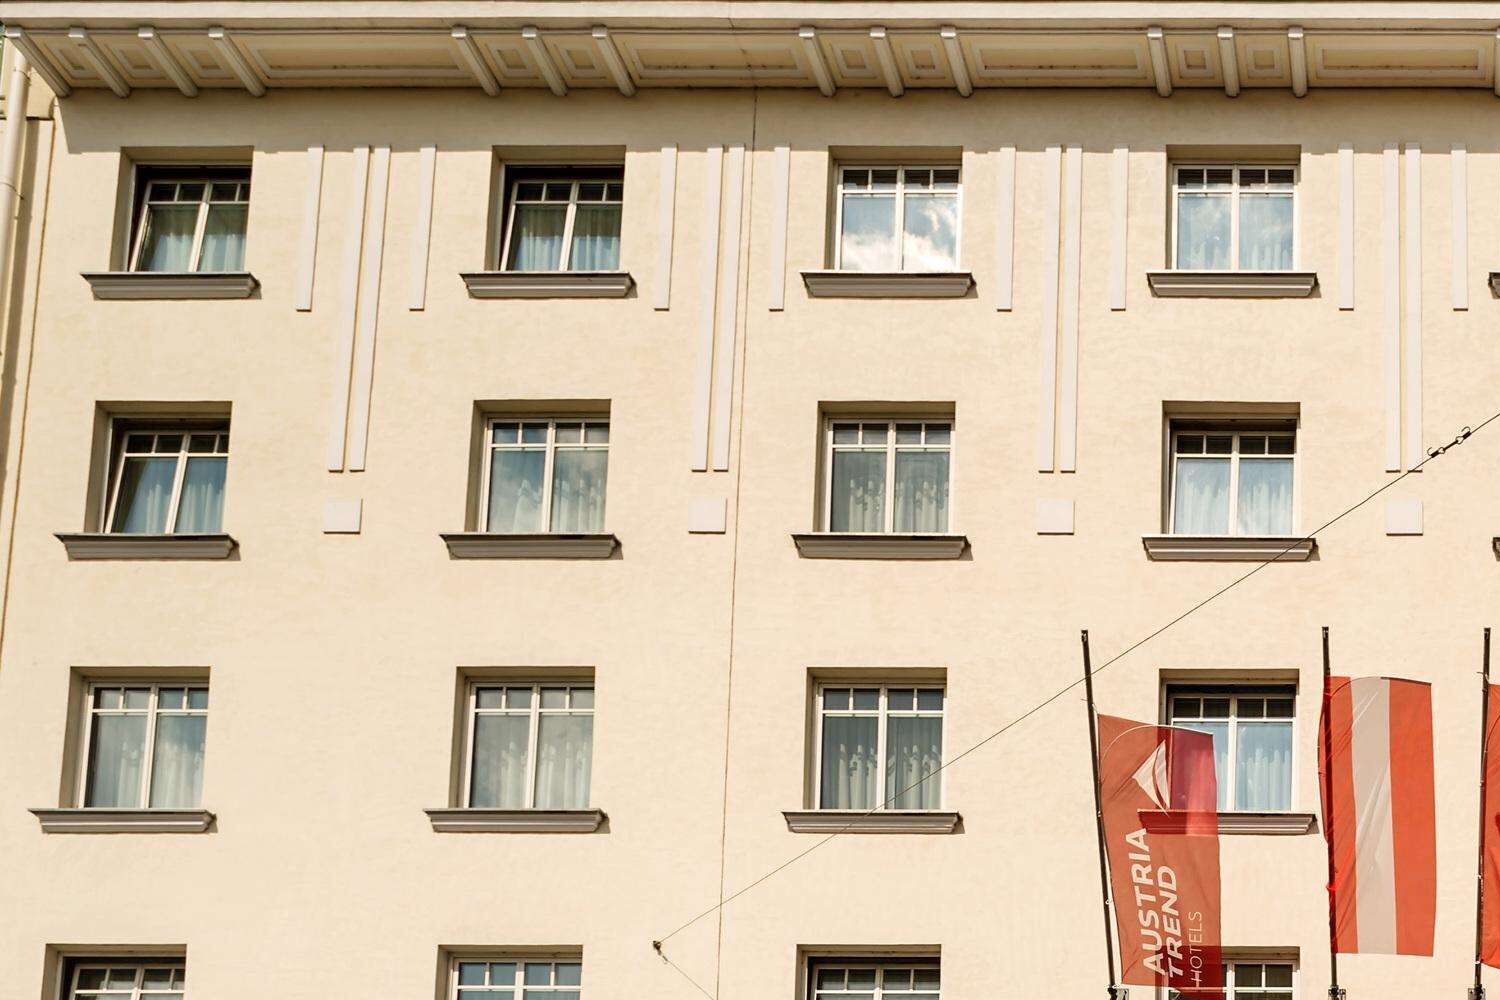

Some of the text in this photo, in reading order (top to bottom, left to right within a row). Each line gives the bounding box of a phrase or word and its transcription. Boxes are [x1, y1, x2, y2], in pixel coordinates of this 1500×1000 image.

[1125, 827, 1167, 977] AUSTRIA
[1157, 865, 1184, 979] TREND
[1188, 911, 1203, 984] HOTELS
